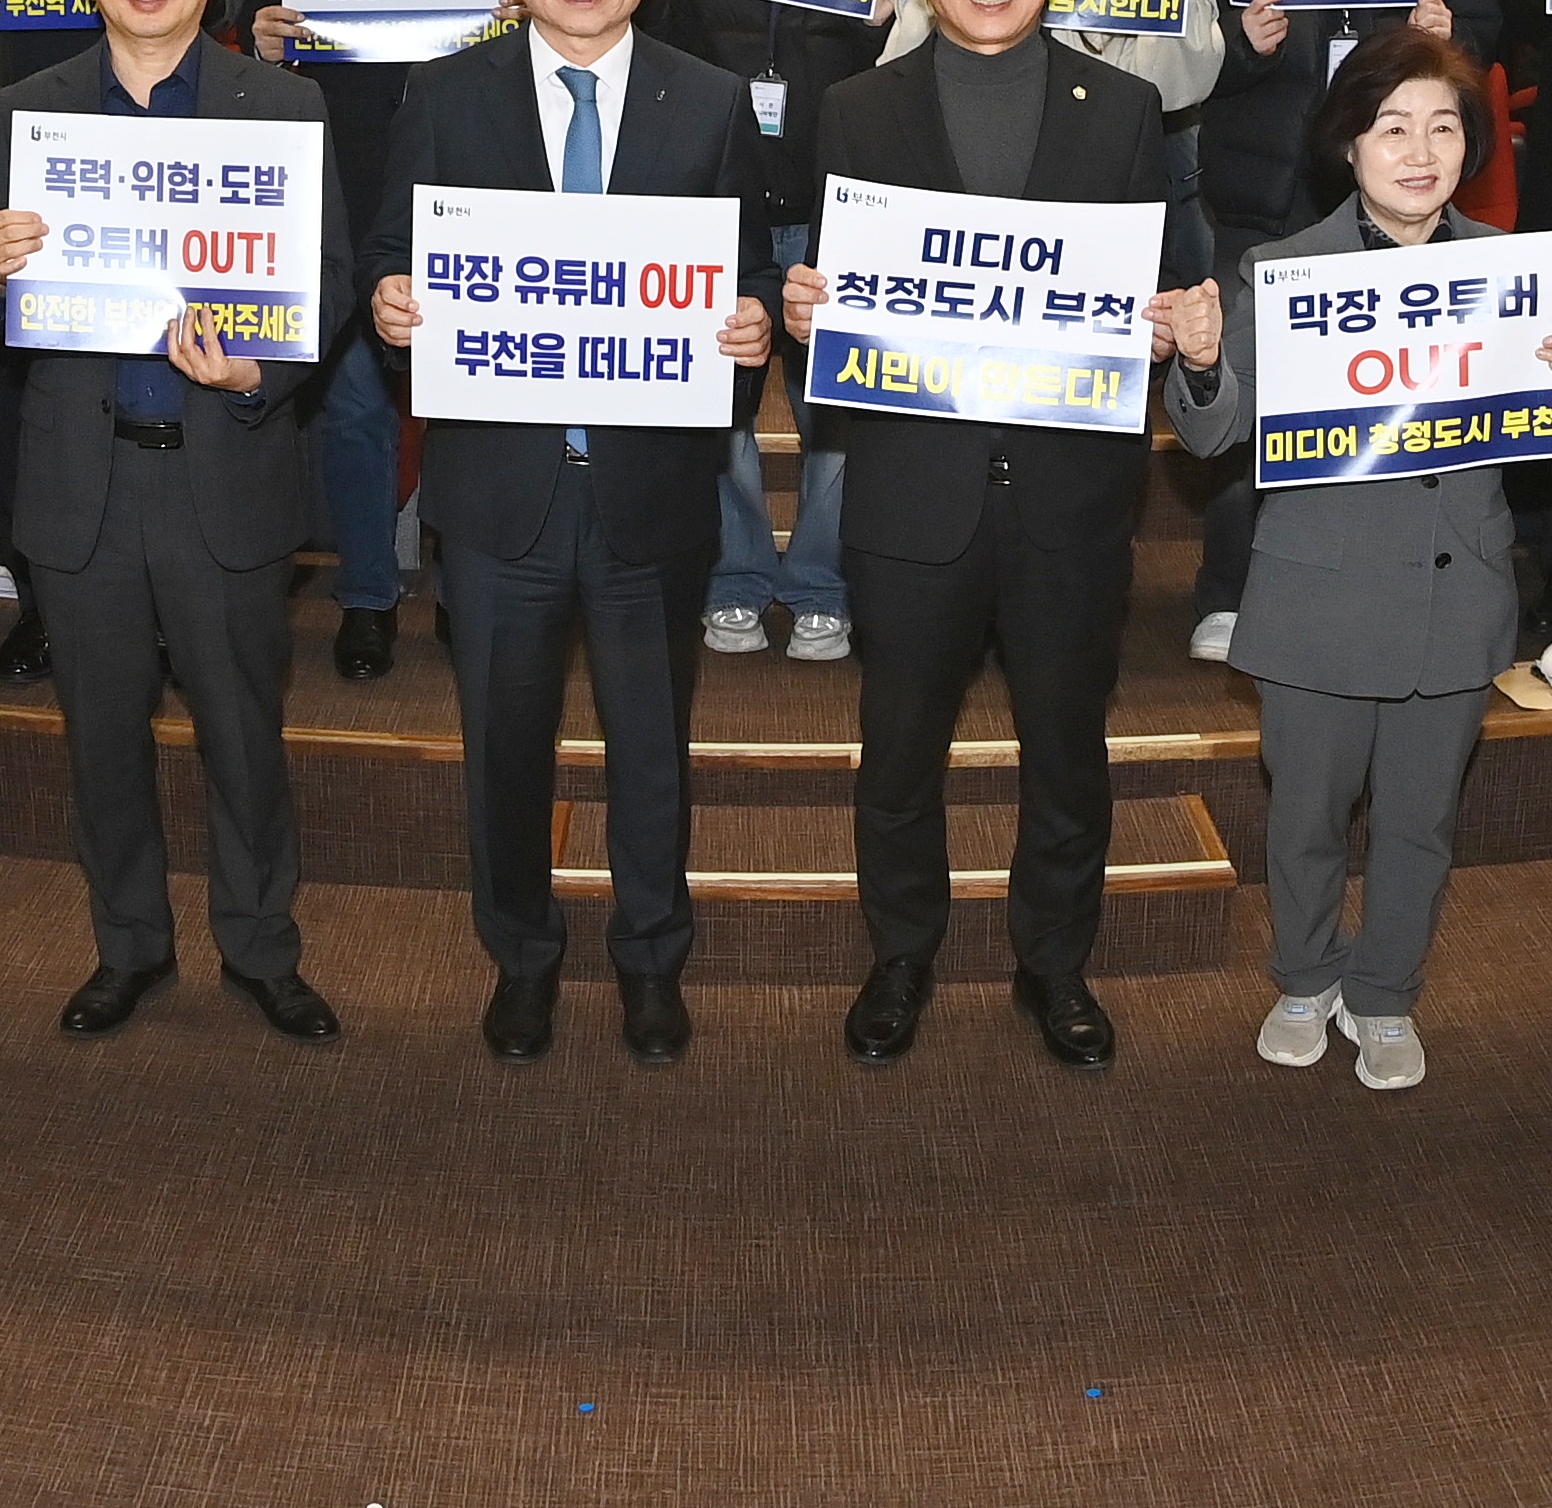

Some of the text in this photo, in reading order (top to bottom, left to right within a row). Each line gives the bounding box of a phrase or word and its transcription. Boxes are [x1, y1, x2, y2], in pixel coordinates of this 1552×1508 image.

[45, 131, 66, 141] 부천시
[45, 157, 288, 206] 폭력·위협·도발
[853, 192, 887, 208] 부천시
[448, 207, 470, 216] 부천시
[62, 224, 275, 276] 유튜버 OUT!
[922, 228, 1063, 275] 미디어
[1278, 268, 1310, 282] 부천시
[428, 253, 723, 309] 막장 유튜버 OUT
[836, 272, 1135, 335] 청정도시 부천
[1289, 274, 1538, 336] 막장 유튜버
[21, 294, 96, 334] 안전한
[455, 330, 693, 382] 부천을 떠나라
[837, 348, 1120, 411] 시민이 만든다!
[1347, 342, 1482, 395] OUT
[1267, 426, 1357, 461] 미디어
[1370, 410, 1491, 453] 청정도시
